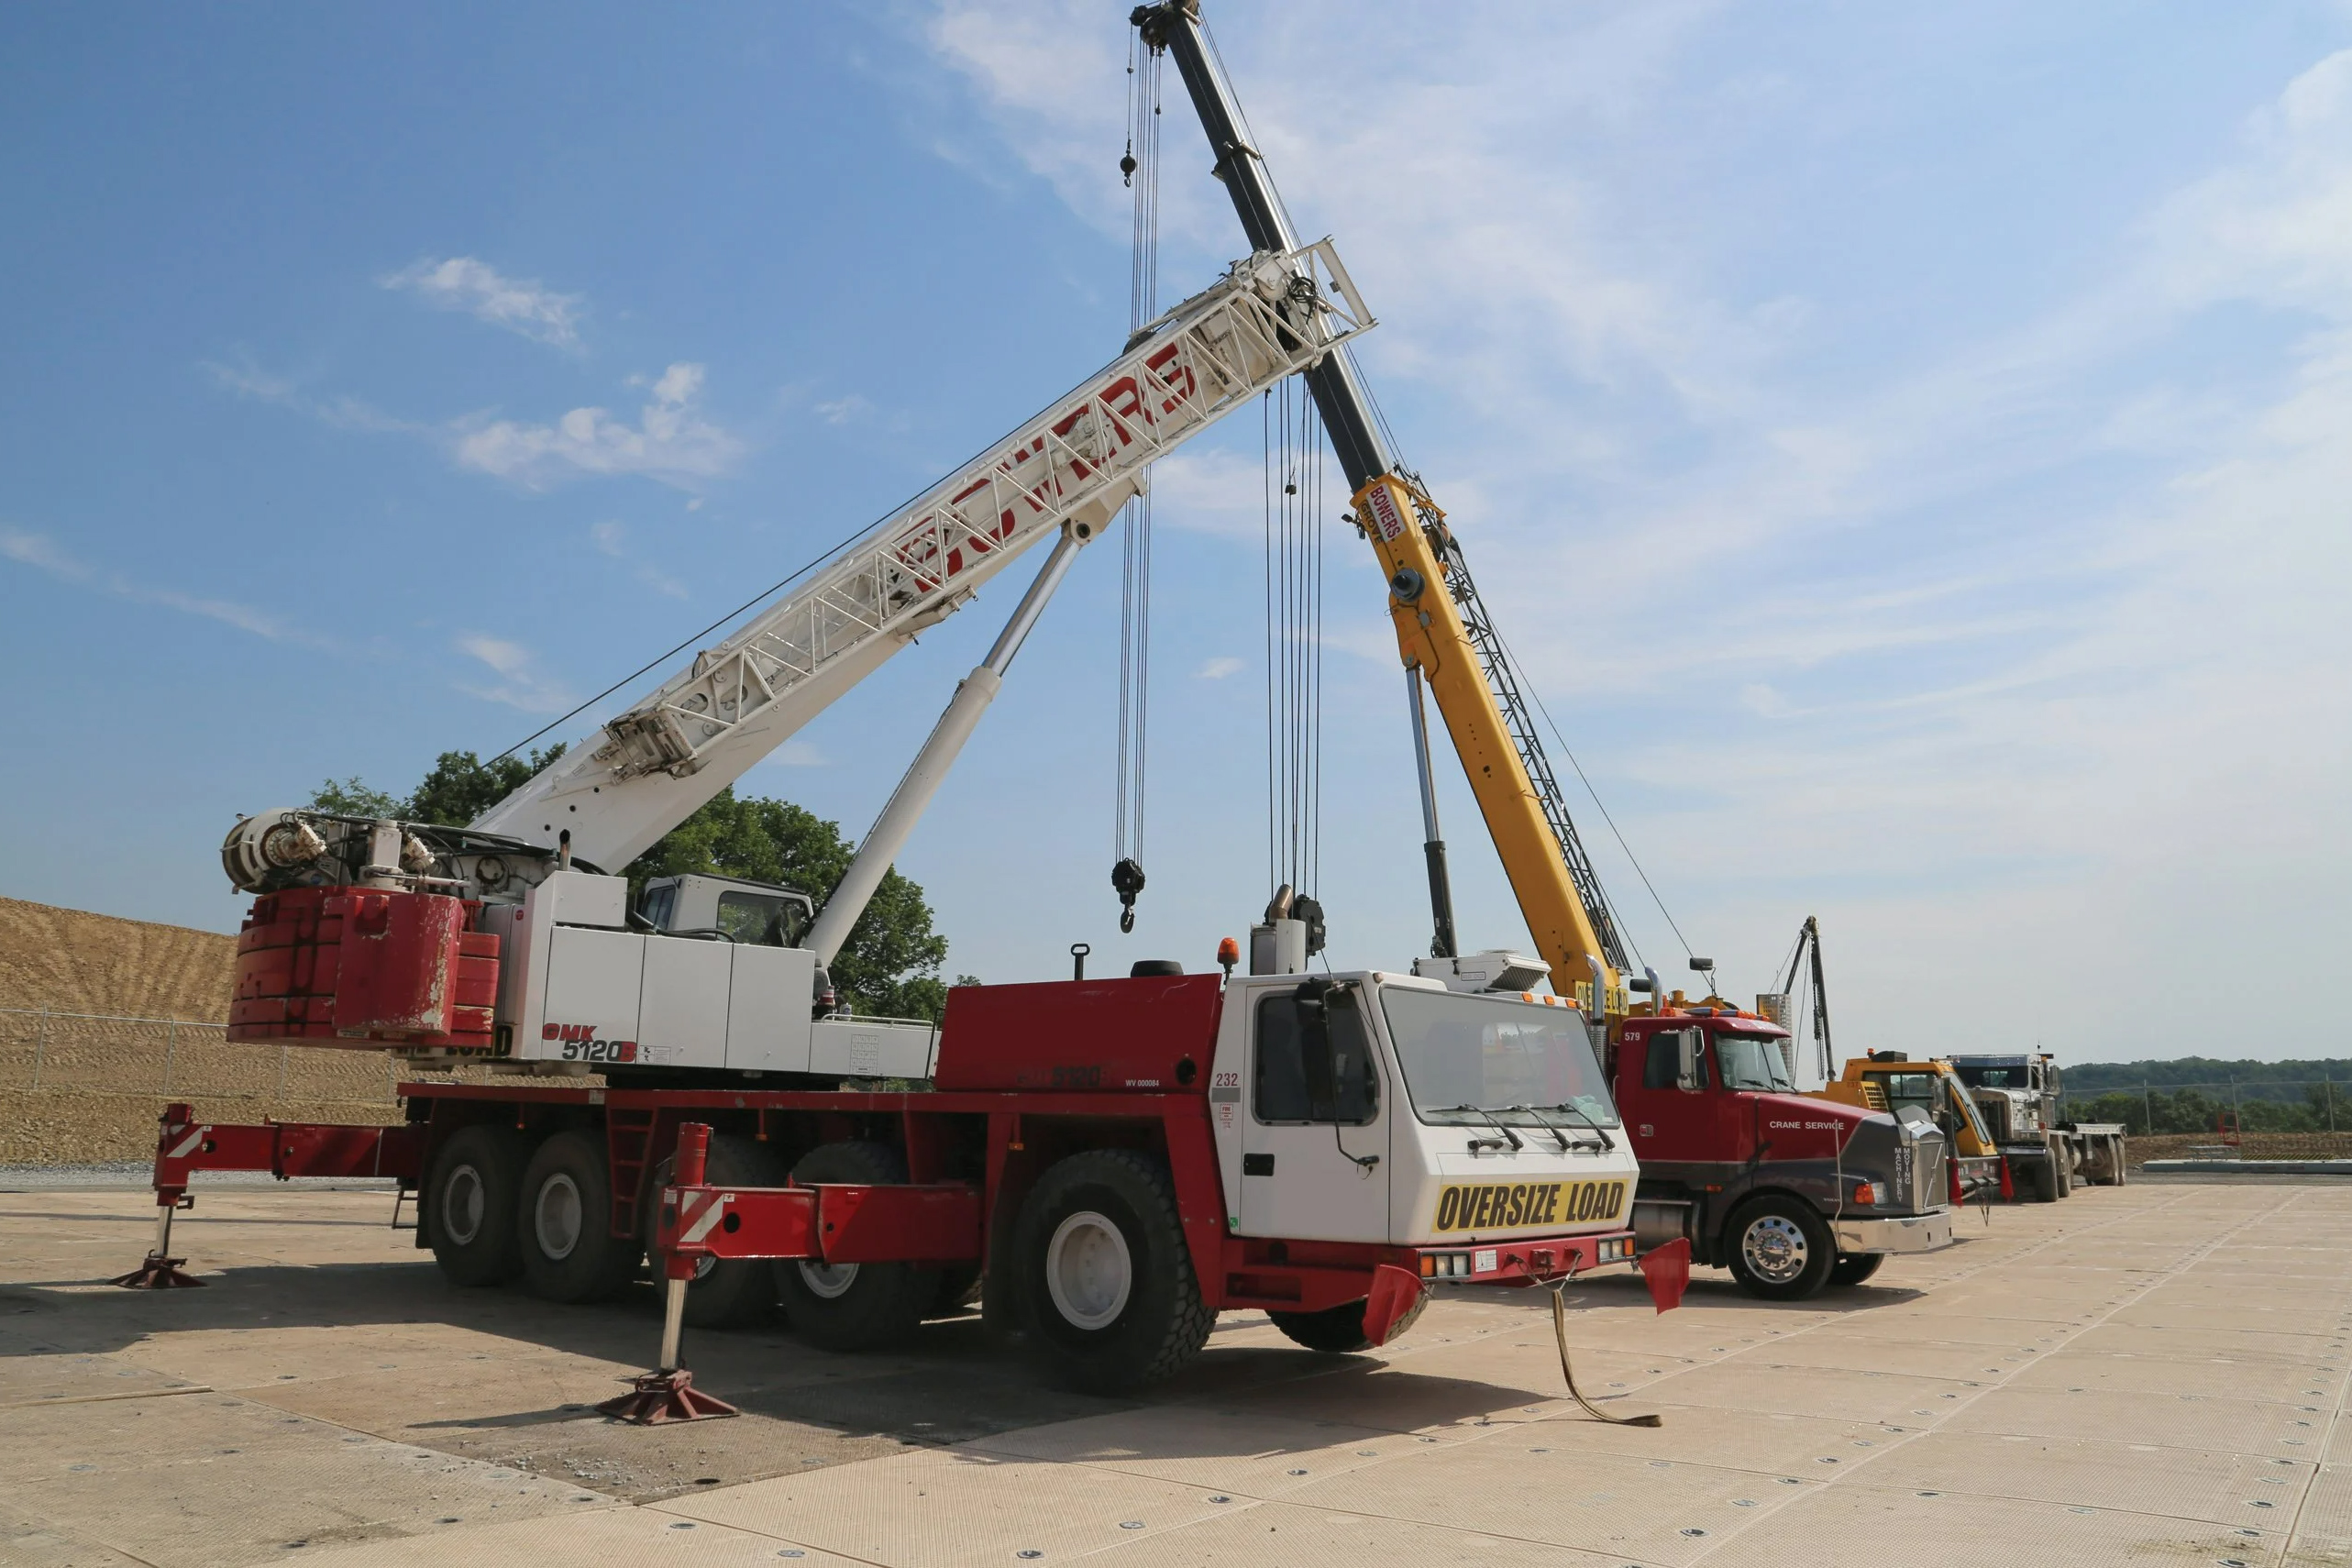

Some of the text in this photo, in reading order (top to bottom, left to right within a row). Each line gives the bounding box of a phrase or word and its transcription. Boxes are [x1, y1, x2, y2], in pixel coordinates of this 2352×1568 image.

[1369, 485, 1401, 538] BOWERS
[542, 1022, 598, 1043] GMK
[1625, 1032, 1640, 1041] 579
[562, 1040, 637, 1063] 5120B
[1125, 1079, 1160, 1088] WV 000084
[1216, 1073, 1239, 1087] 232
[1769, 1121, 1845, 1130] CRANE SERVICE
[1894, 1147, 1903, 1202] MACHINERY
[1903, 1147, 1911, 1185] MOVING
[1437, 1182, 1625, 1231] OVERSIZE LOAD
